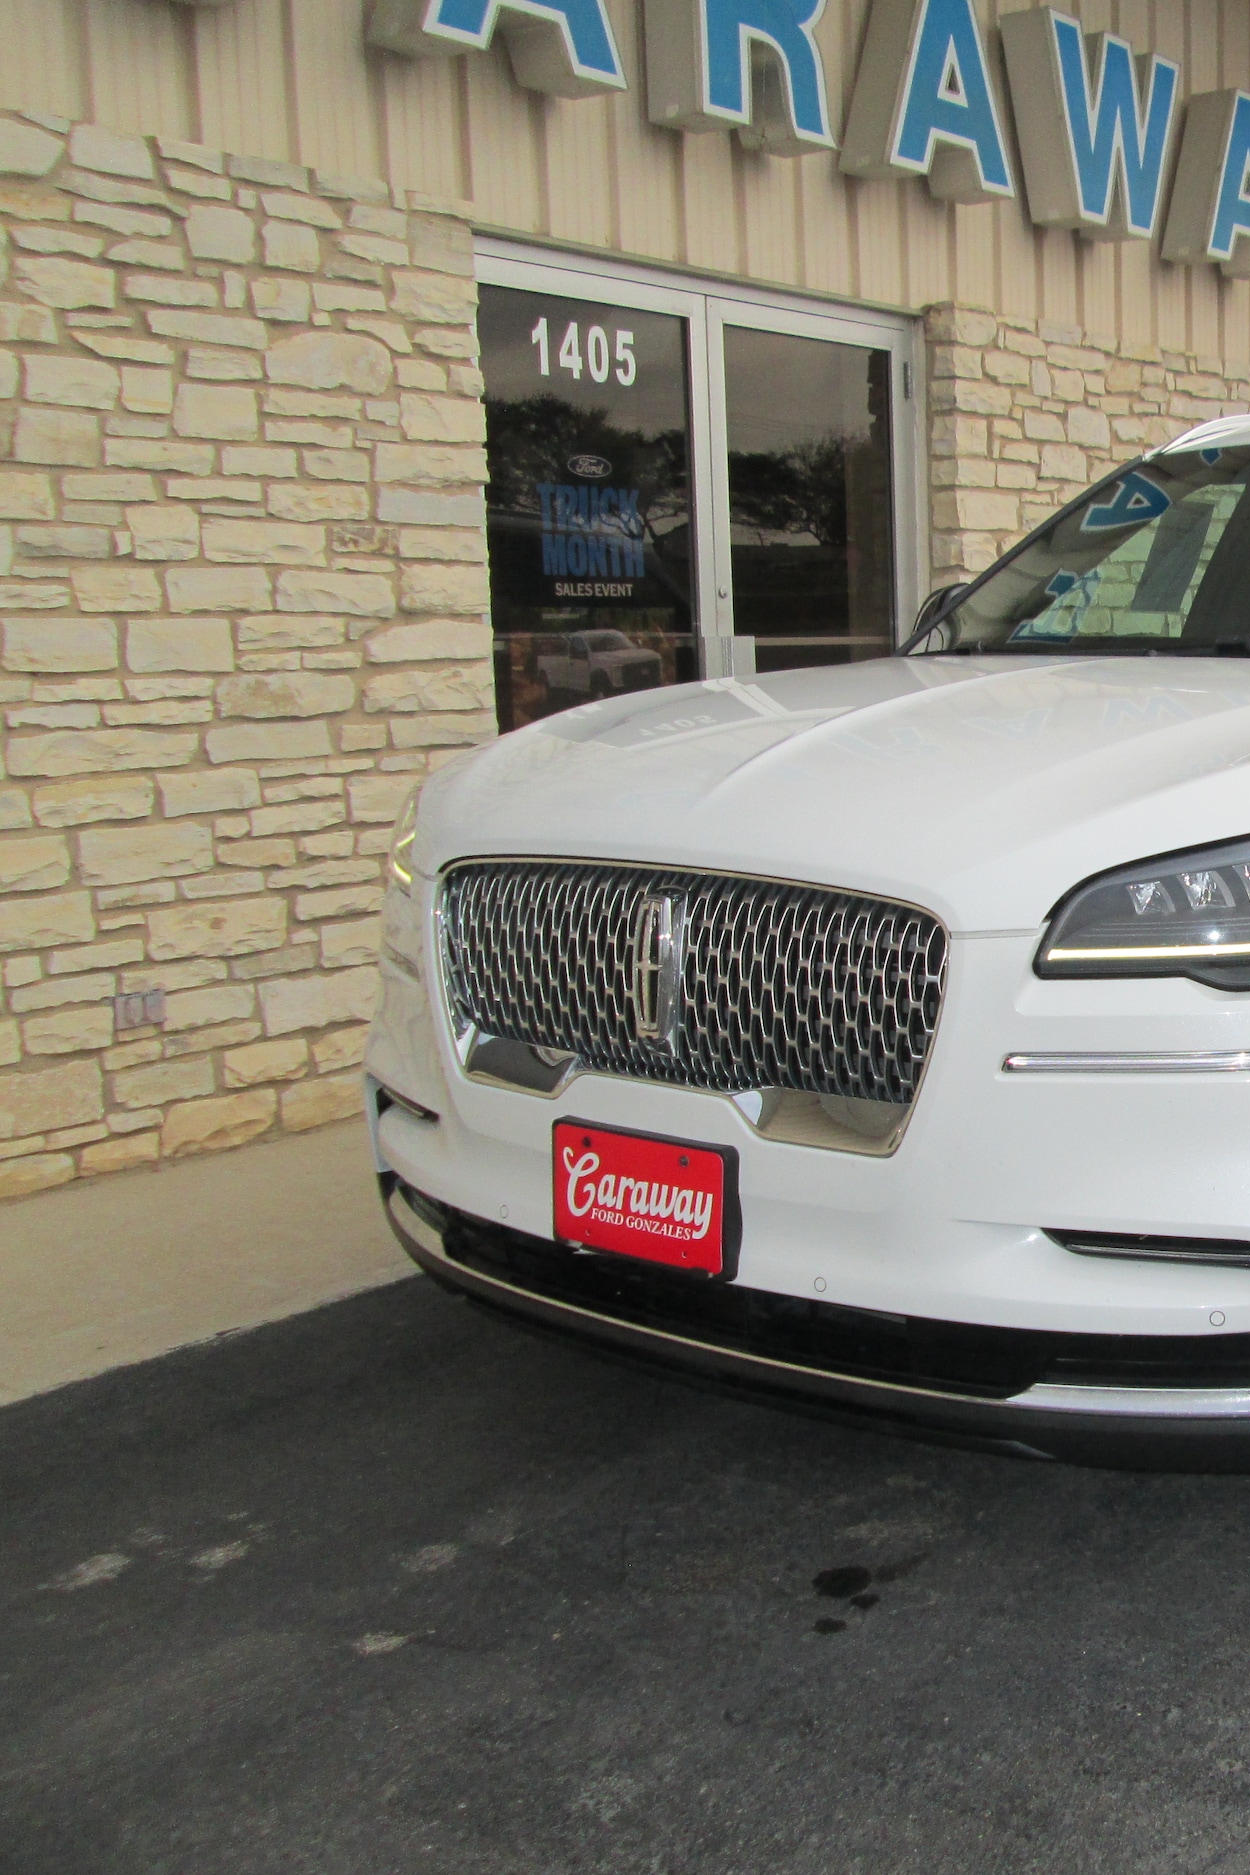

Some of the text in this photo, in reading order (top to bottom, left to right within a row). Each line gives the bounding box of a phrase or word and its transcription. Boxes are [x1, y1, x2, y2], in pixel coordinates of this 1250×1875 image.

[531, 316, 637, 387] 1405
[574, 456, 605, 475] Ford
[536, 482, 645, 537] TRUCK
[542, 532, 645, 579] MONTH
[555, 582, 633, 597] SALES EVENT
[563, 1146, 713, 1240] Caraway
[590, 1207, 692, 1241] FORD GONZALES
